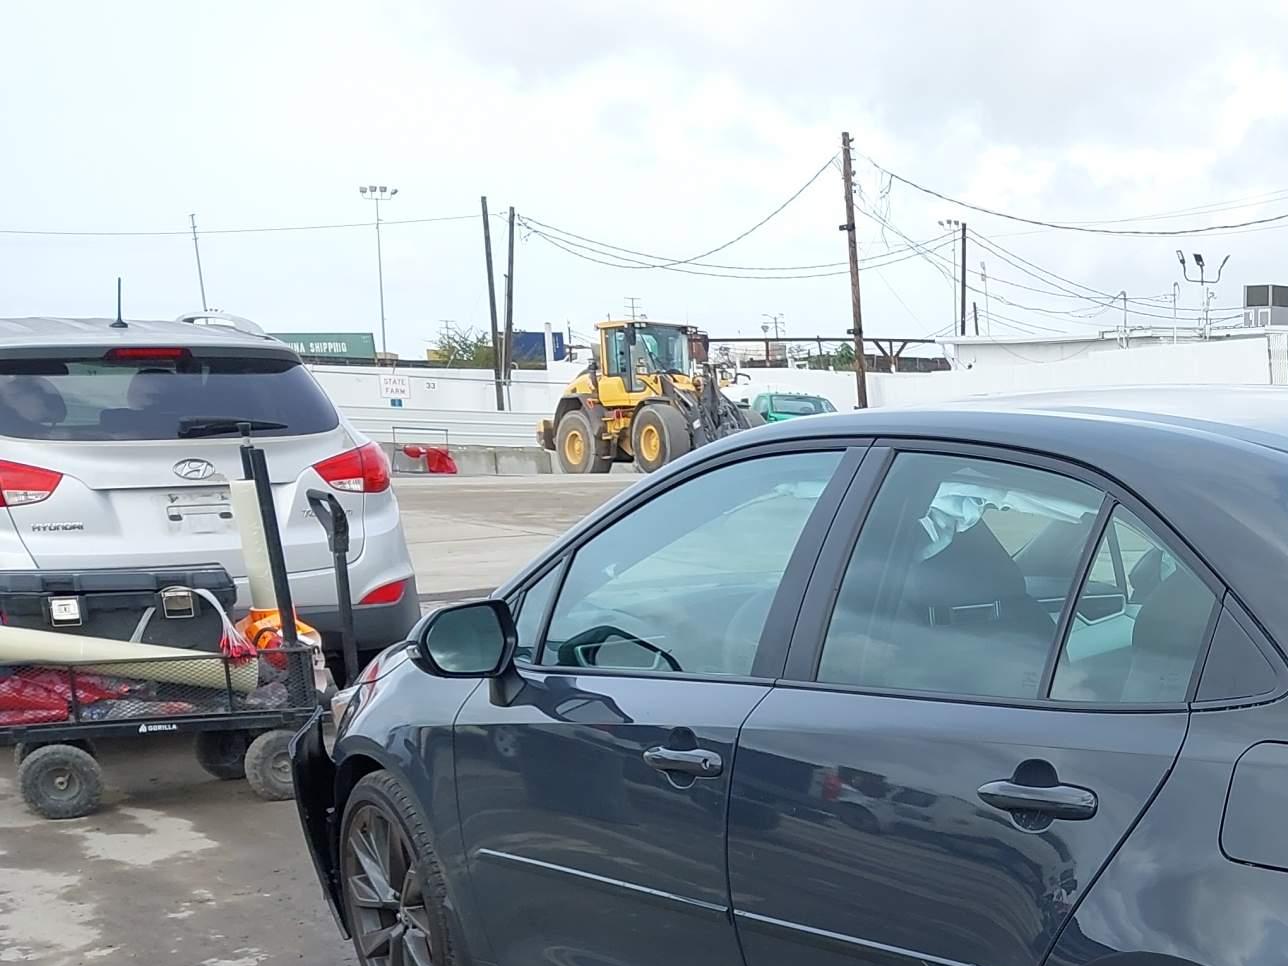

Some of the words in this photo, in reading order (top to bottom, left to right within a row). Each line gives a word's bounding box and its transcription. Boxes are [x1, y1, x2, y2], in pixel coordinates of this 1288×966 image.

[309, 341, 348, 353] SHIPPING
[383, 378, 406, 386] STATE
[425, 382, 436, 390] 33
[385, 387, 406, 395] FARM
[31, 522, 84, 532] HYUNDAI
